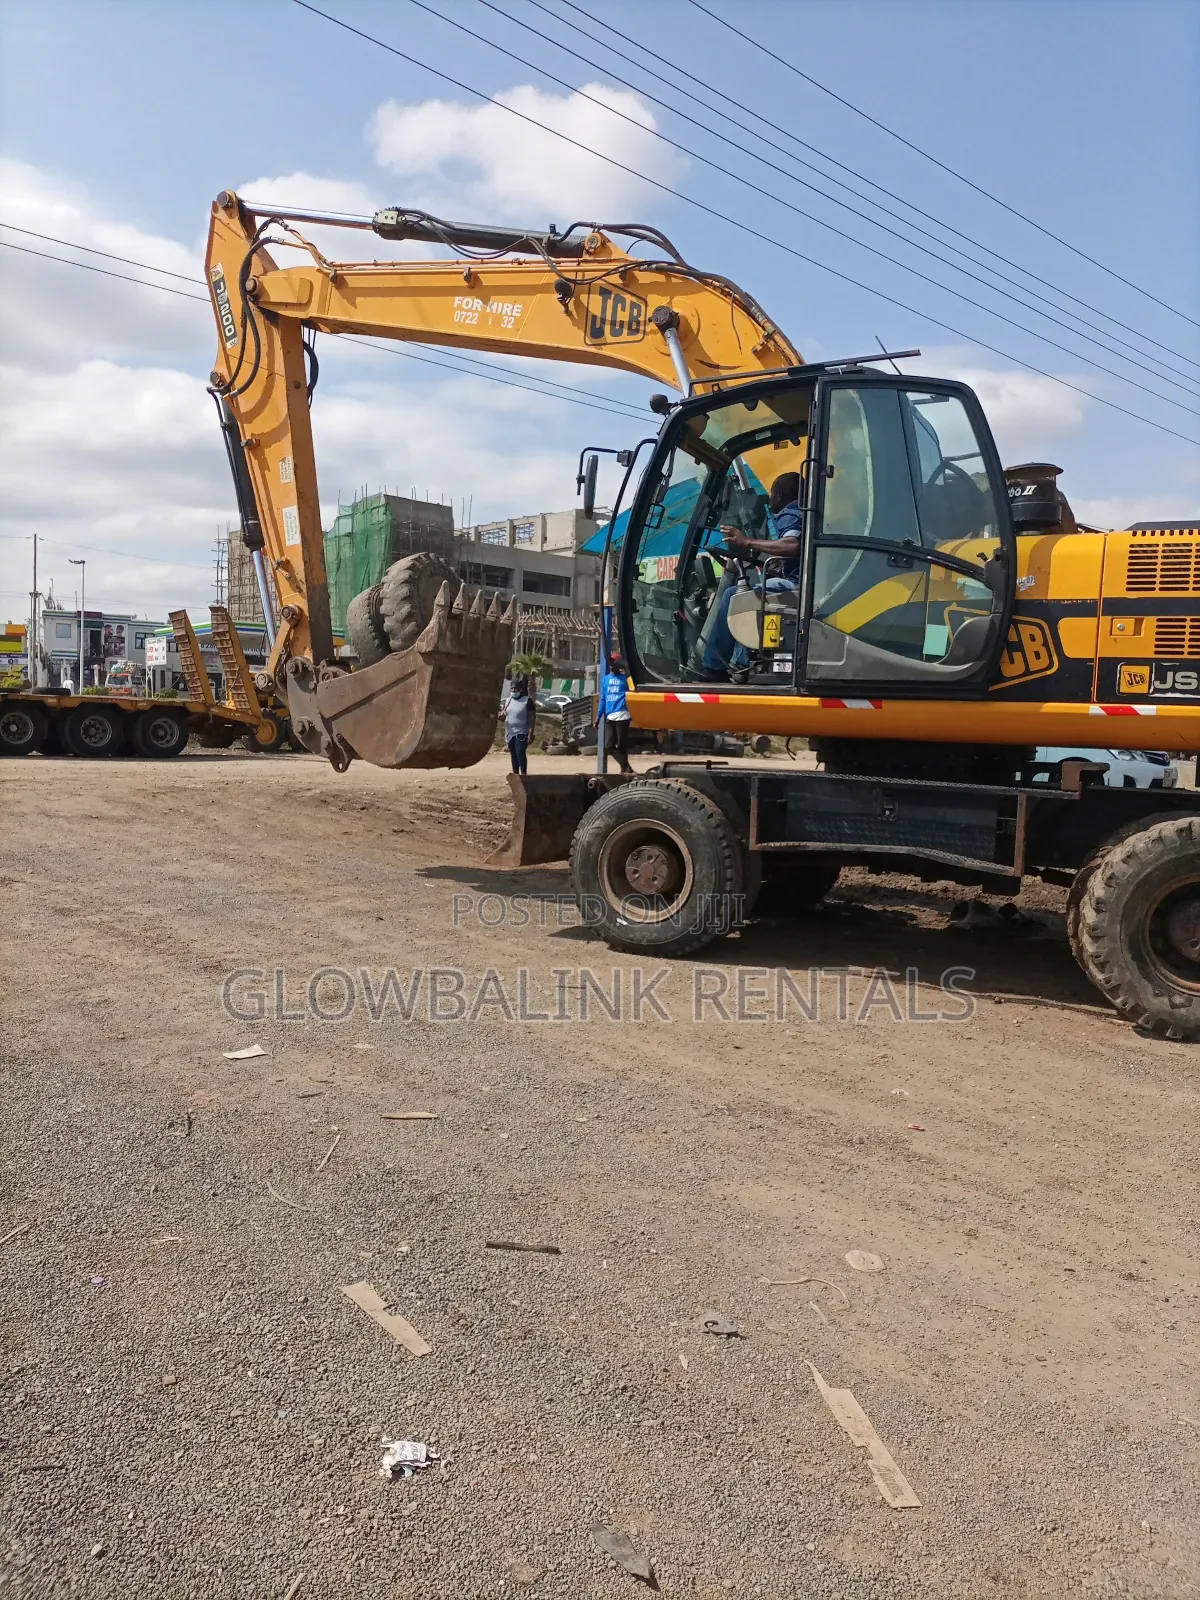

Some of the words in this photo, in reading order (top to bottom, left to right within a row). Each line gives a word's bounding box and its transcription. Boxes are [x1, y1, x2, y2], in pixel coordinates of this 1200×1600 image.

[453, 296, 483, 312] FOR
[486, 300, 523, 317] HIRE
[589, 285, 643, 340] JCB
[453, 310, 479, 325] 0722
[1000, 623, 1050, 678] CB
[1127, 672, 1146, 687] JCB
[1154, 671, 1200, 690] JS
